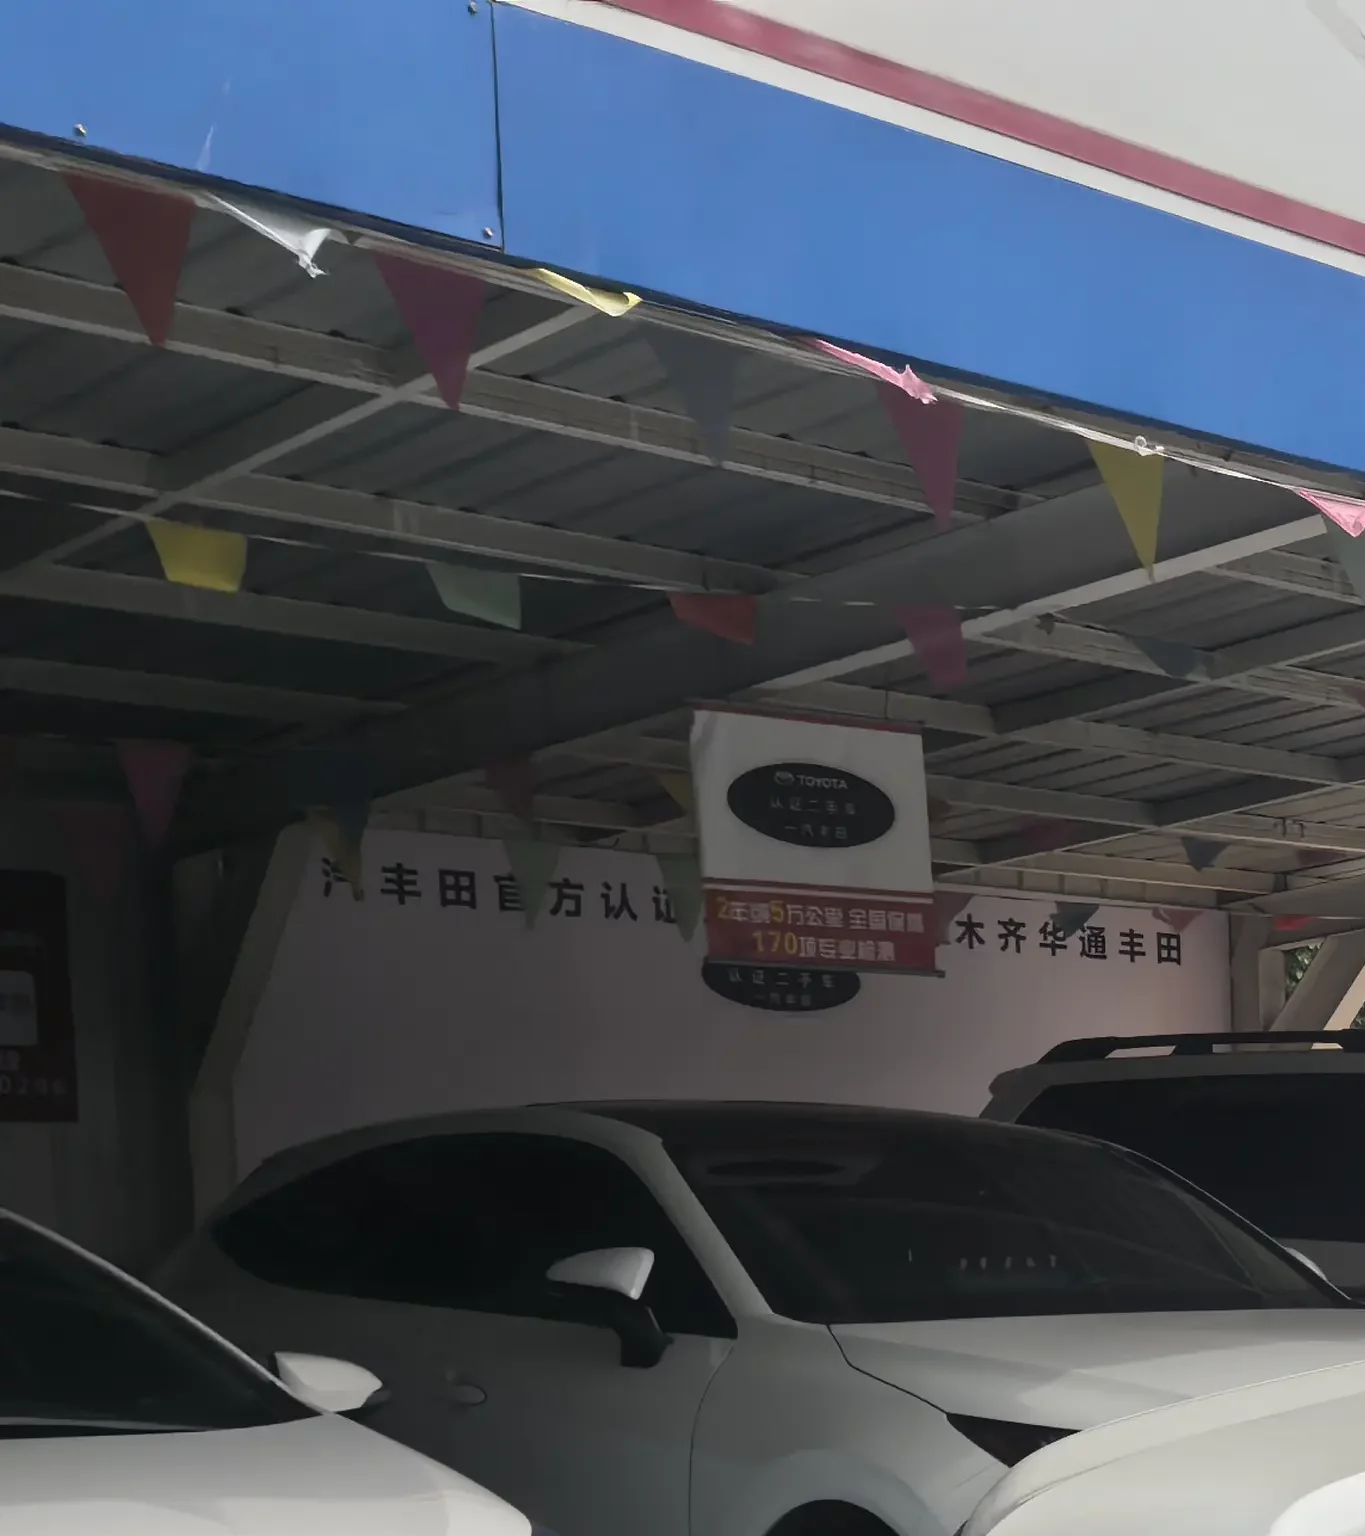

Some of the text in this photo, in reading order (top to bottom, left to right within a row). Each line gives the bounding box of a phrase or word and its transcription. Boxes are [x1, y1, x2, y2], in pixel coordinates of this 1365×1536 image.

[797, 774, 848, 790] TOYOTA
[954, 913, 1182, 966] 木齐华通丰田
